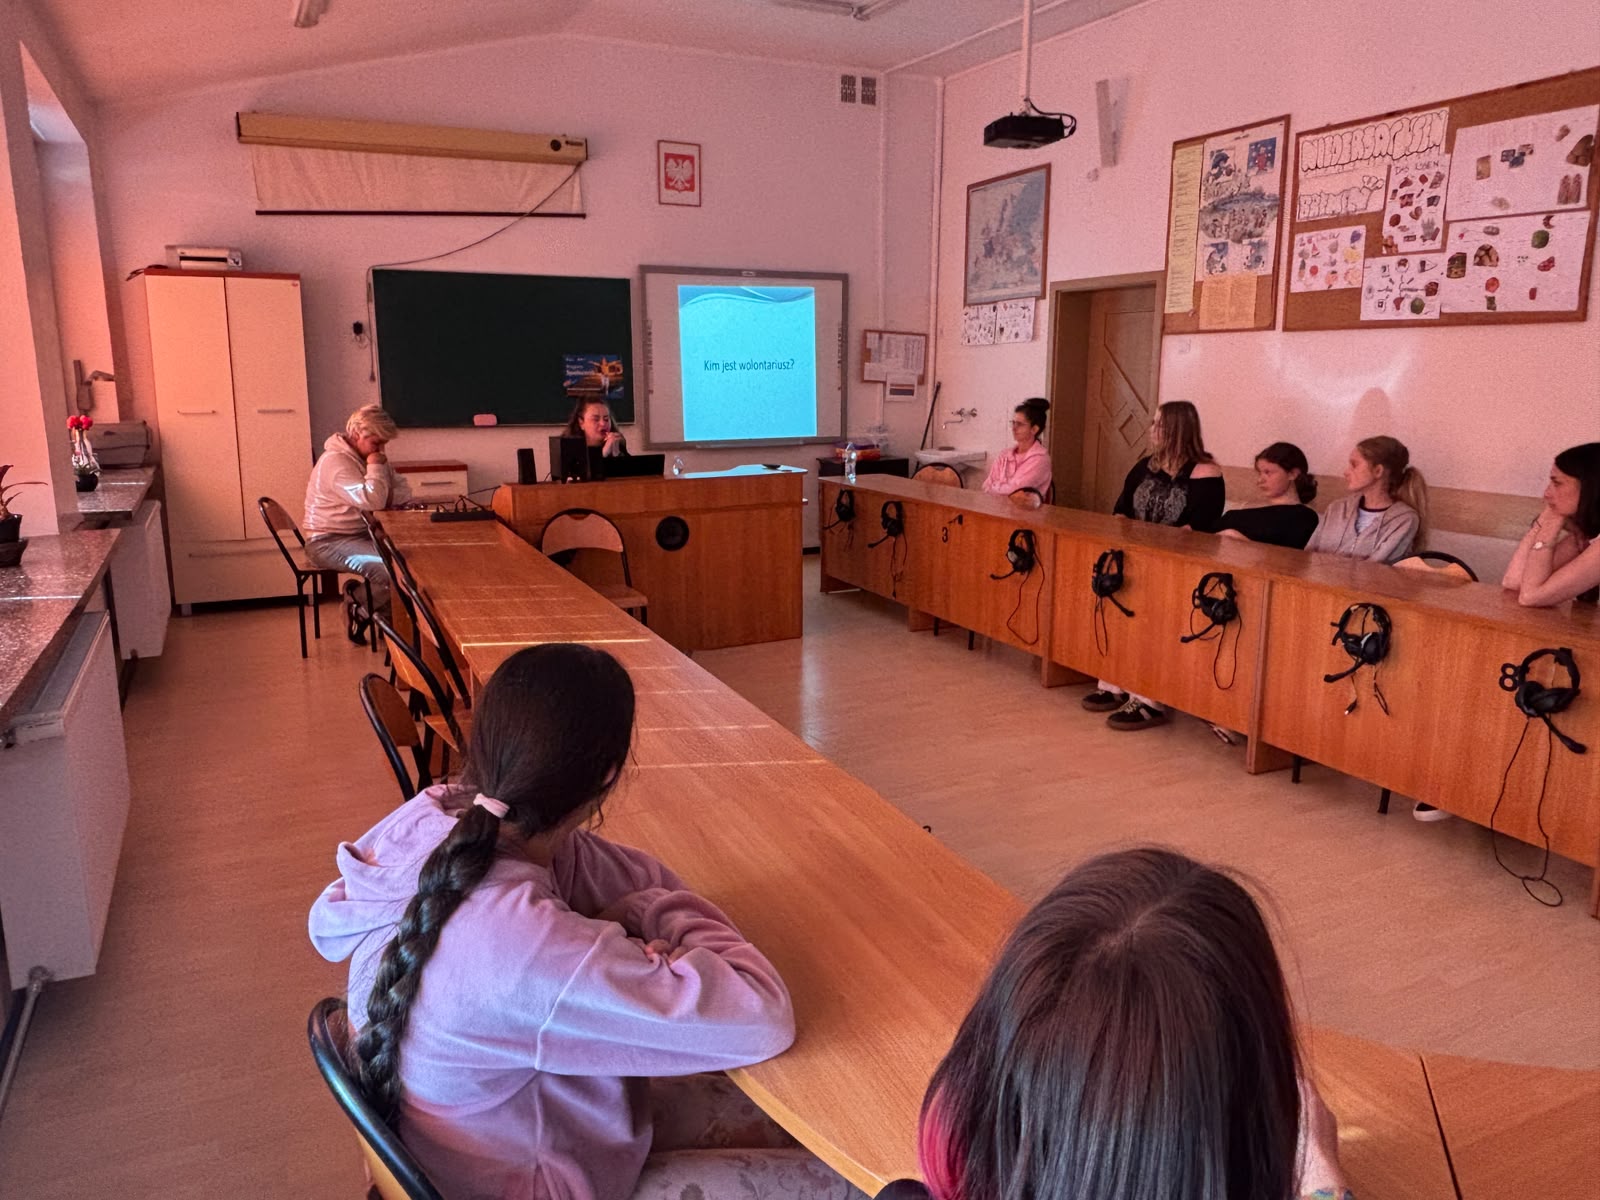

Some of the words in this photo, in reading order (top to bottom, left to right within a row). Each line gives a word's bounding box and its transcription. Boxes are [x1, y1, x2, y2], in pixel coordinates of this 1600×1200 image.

[704, 360, 719, 371] Kim
[721, 361, 736, 373] jest
[738, 358, 795, 371] wolontariusz?
[942, 526, 948, 543] 3
[1499, 662, 1519, 692] 8
